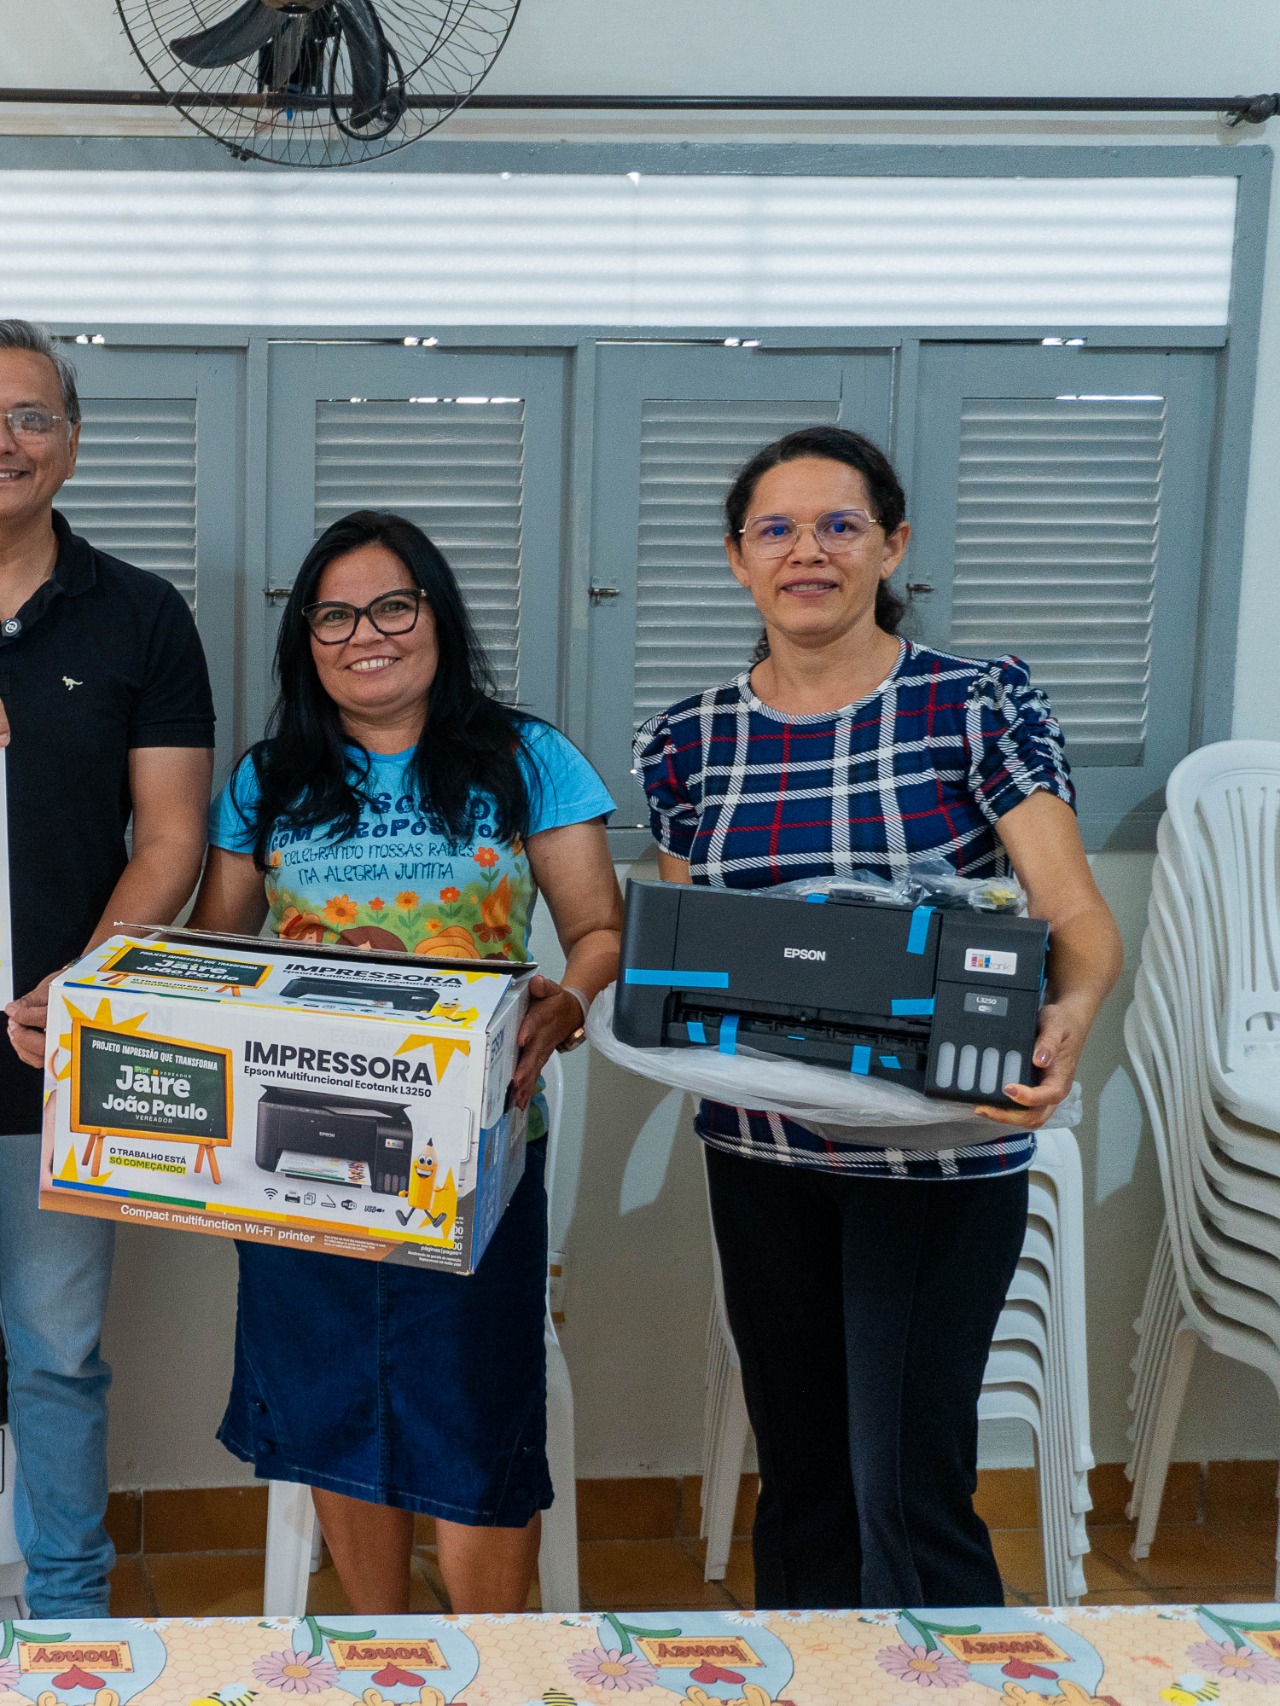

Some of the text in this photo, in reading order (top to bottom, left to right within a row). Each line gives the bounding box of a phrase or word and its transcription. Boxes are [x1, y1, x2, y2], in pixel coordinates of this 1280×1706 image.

[369, 843, 423, 858] NOSSAS
[298, 866, 320, 886] NA
[324, 864, 389, 883] ALEGRIA
[783, 947, 826, 961] EPSON
[155, 959, 228, 974] Jaire
[184, 969, 240, 981] Paulo
[285, 963, 463, 985] IMPRESSORA
[91, 1040, 218, 1071] PROJETO IMPRESSÃO QUE TRANSFORMA
[244, 1040, 434, 1086] IMPRESSORA
[115, 1064, 191, 1098] Jaire
[244, 1065, 432, 1098] Epson Multifuncional Ecotank L3250
[102, 1094, 208, 1121] João Paulo
[135, 1114, 173, 1124] VEREADOR
[109, 1156, 186, 1174] SÓ COMEÇANDO!
[117, 1148, 164, 1161] TRABALHO
[164, 1155, 187, 1165] ESTÁ
[120, 1204, 170, 1222] Compact
[171, 1212, 243, 1232] multifunction
[278, 1228, 316, 1243] printer
[32, 1648, 120, 1667] honey
[345, 1645, 434, 1664] honey
[657, 1642, 747, 1662] honey
